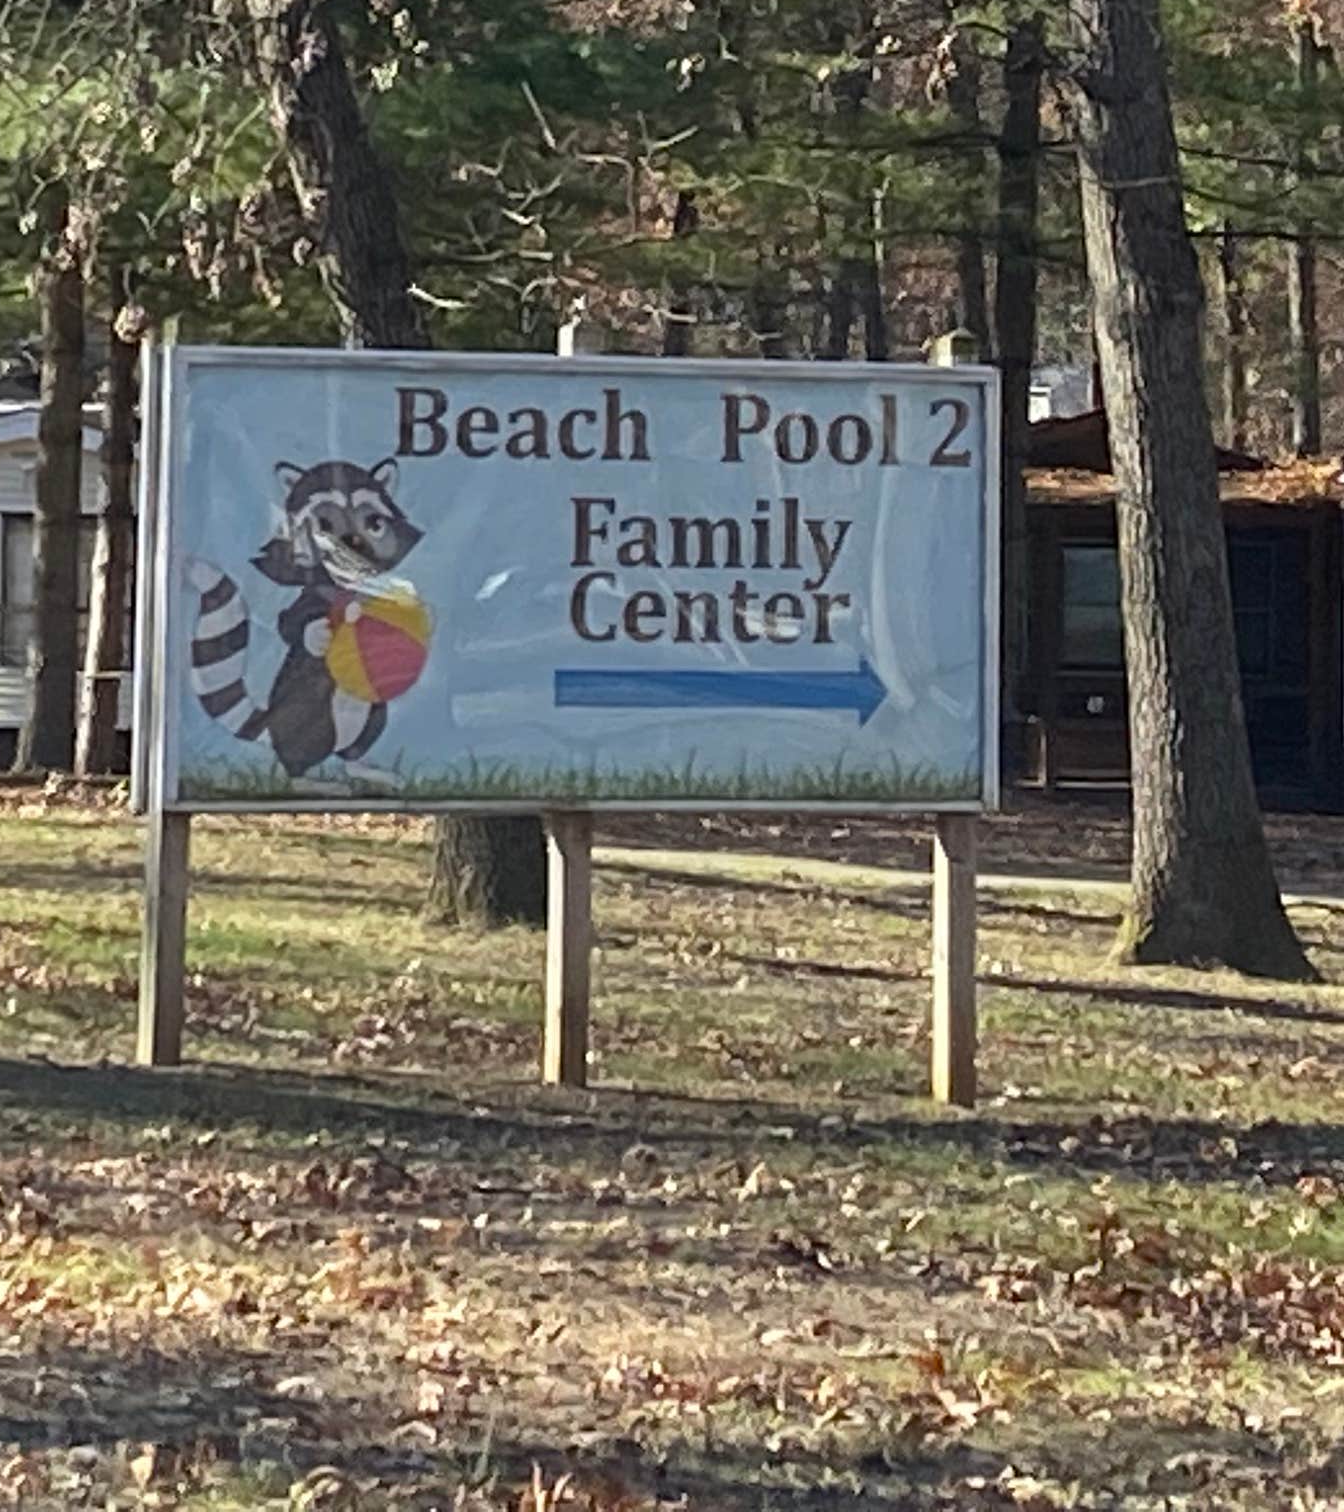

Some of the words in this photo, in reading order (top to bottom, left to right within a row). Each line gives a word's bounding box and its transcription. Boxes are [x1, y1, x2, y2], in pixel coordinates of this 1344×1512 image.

[394, 386, 651, 463] Beach
[721, 392, 900, 467] Pool
[929, 398, 973, 468] 2
[569, 496, 852, 590] Family
[569, 572, 852, 646] Center
